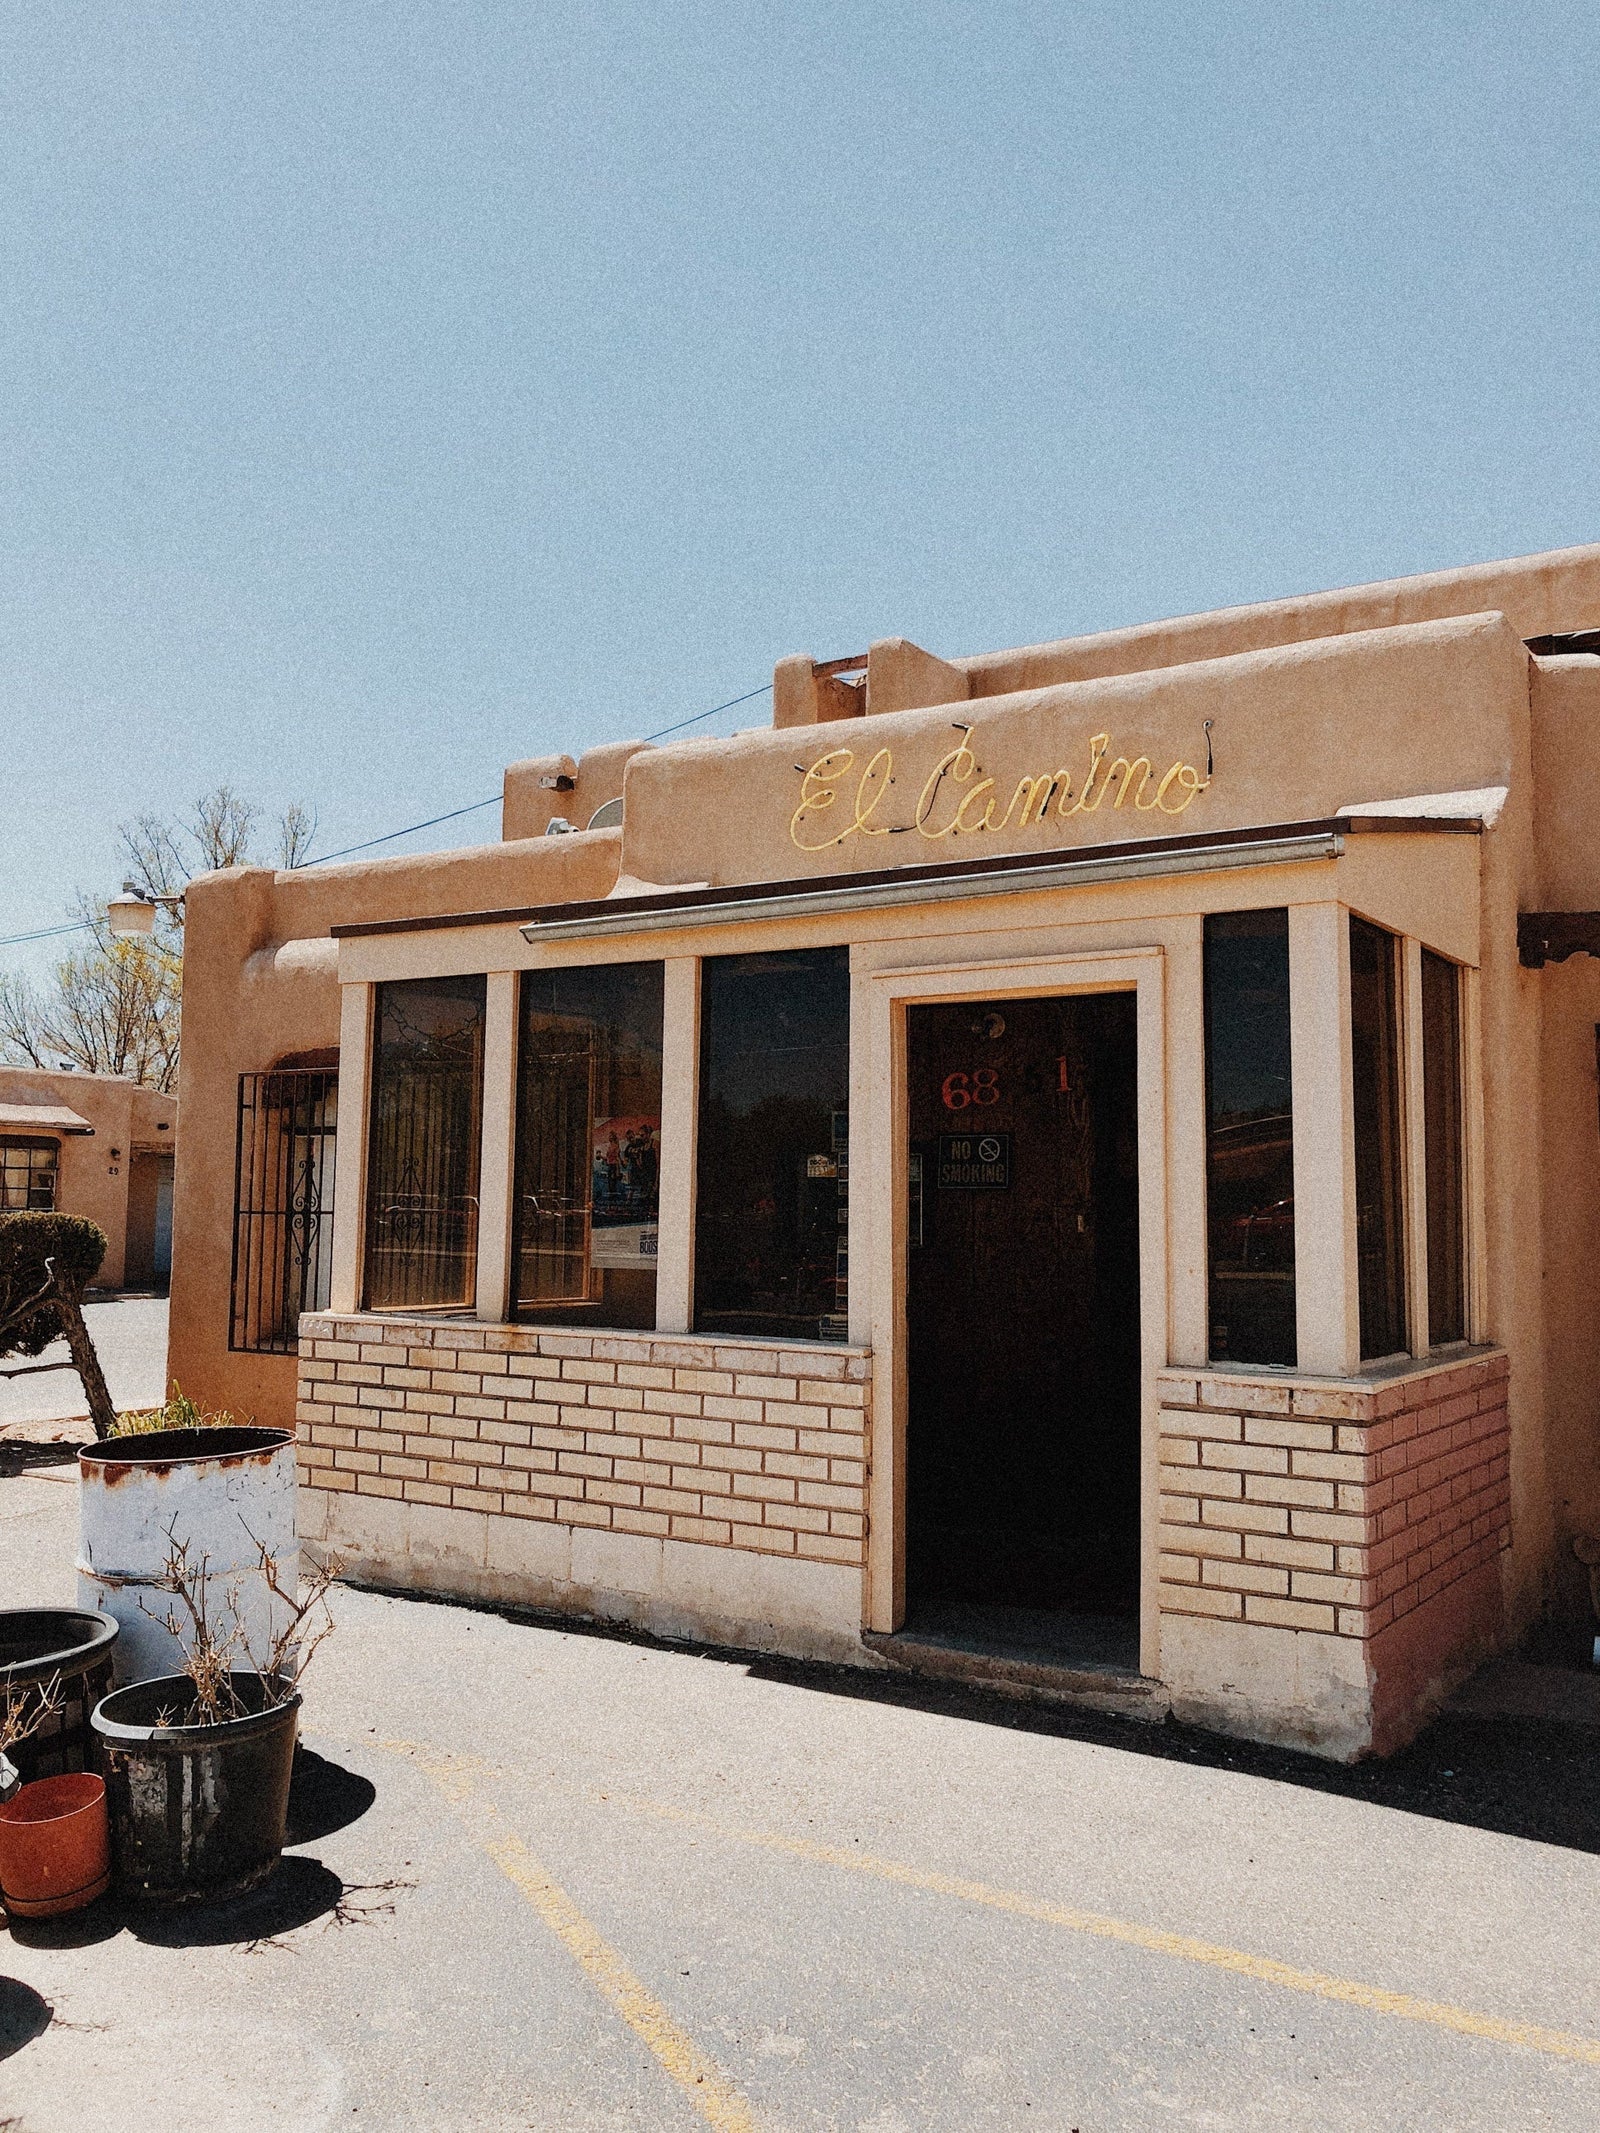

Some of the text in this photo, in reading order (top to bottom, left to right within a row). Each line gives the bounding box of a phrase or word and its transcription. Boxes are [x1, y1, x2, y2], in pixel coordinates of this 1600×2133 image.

[790, 726, 1210, 851] El Camino
[951, 1141, 971, 1160] NO
[942, 1163, 1005, 1184] SMOKING
[639, 1240, 658, 1254] BOOS
